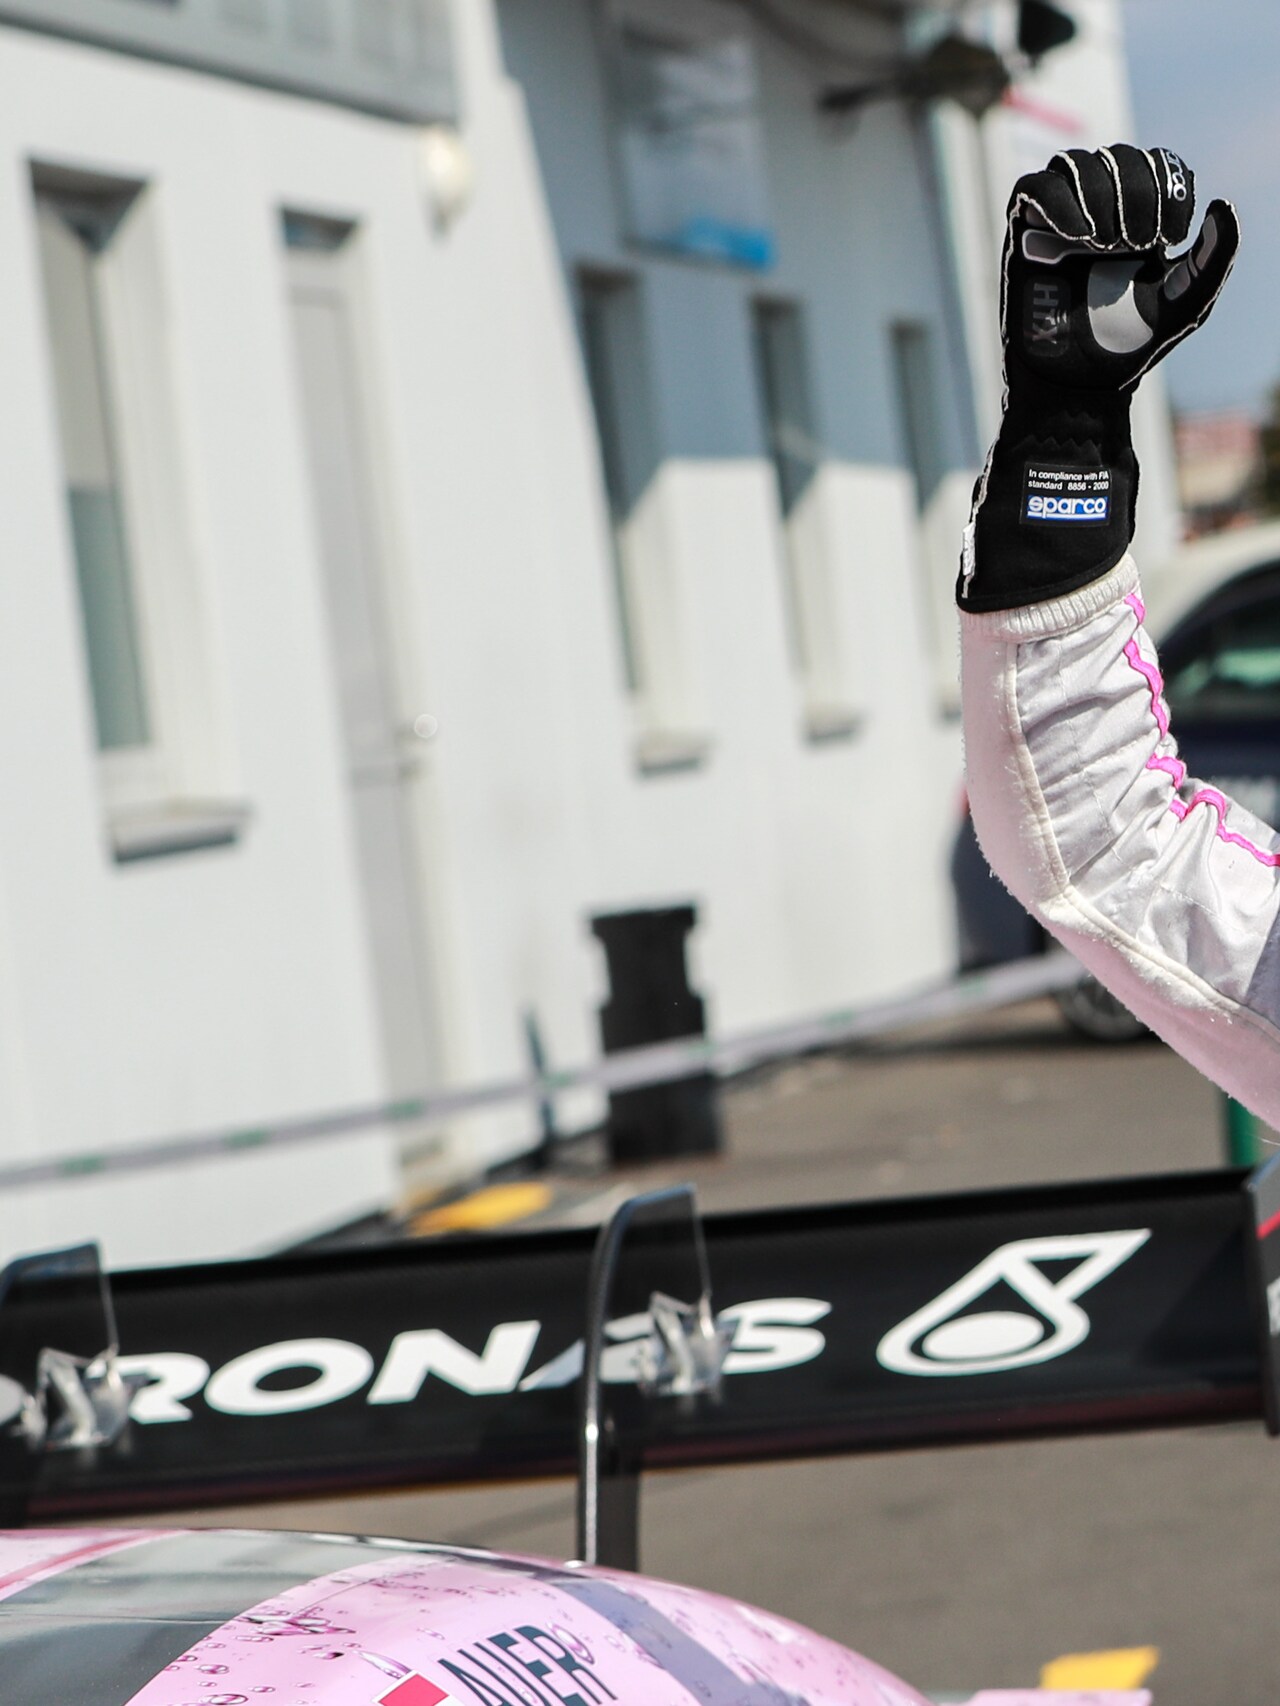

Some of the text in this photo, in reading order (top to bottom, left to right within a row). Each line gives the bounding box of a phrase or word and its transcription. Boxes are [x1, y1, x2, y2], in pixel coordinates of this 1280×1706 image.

[1033, 282, 1058, 344] HTX
[1028, 468, 1110, 482] In compliance with FIA
[1028, 480, 1063, 490] standard
[1093, 481, 1110, 491] 2000
[1028, 495, 1107, 519] sparco
[0, 1296, 833, 1425] RONAS
[437, 1625, 619, 1706] AUER
